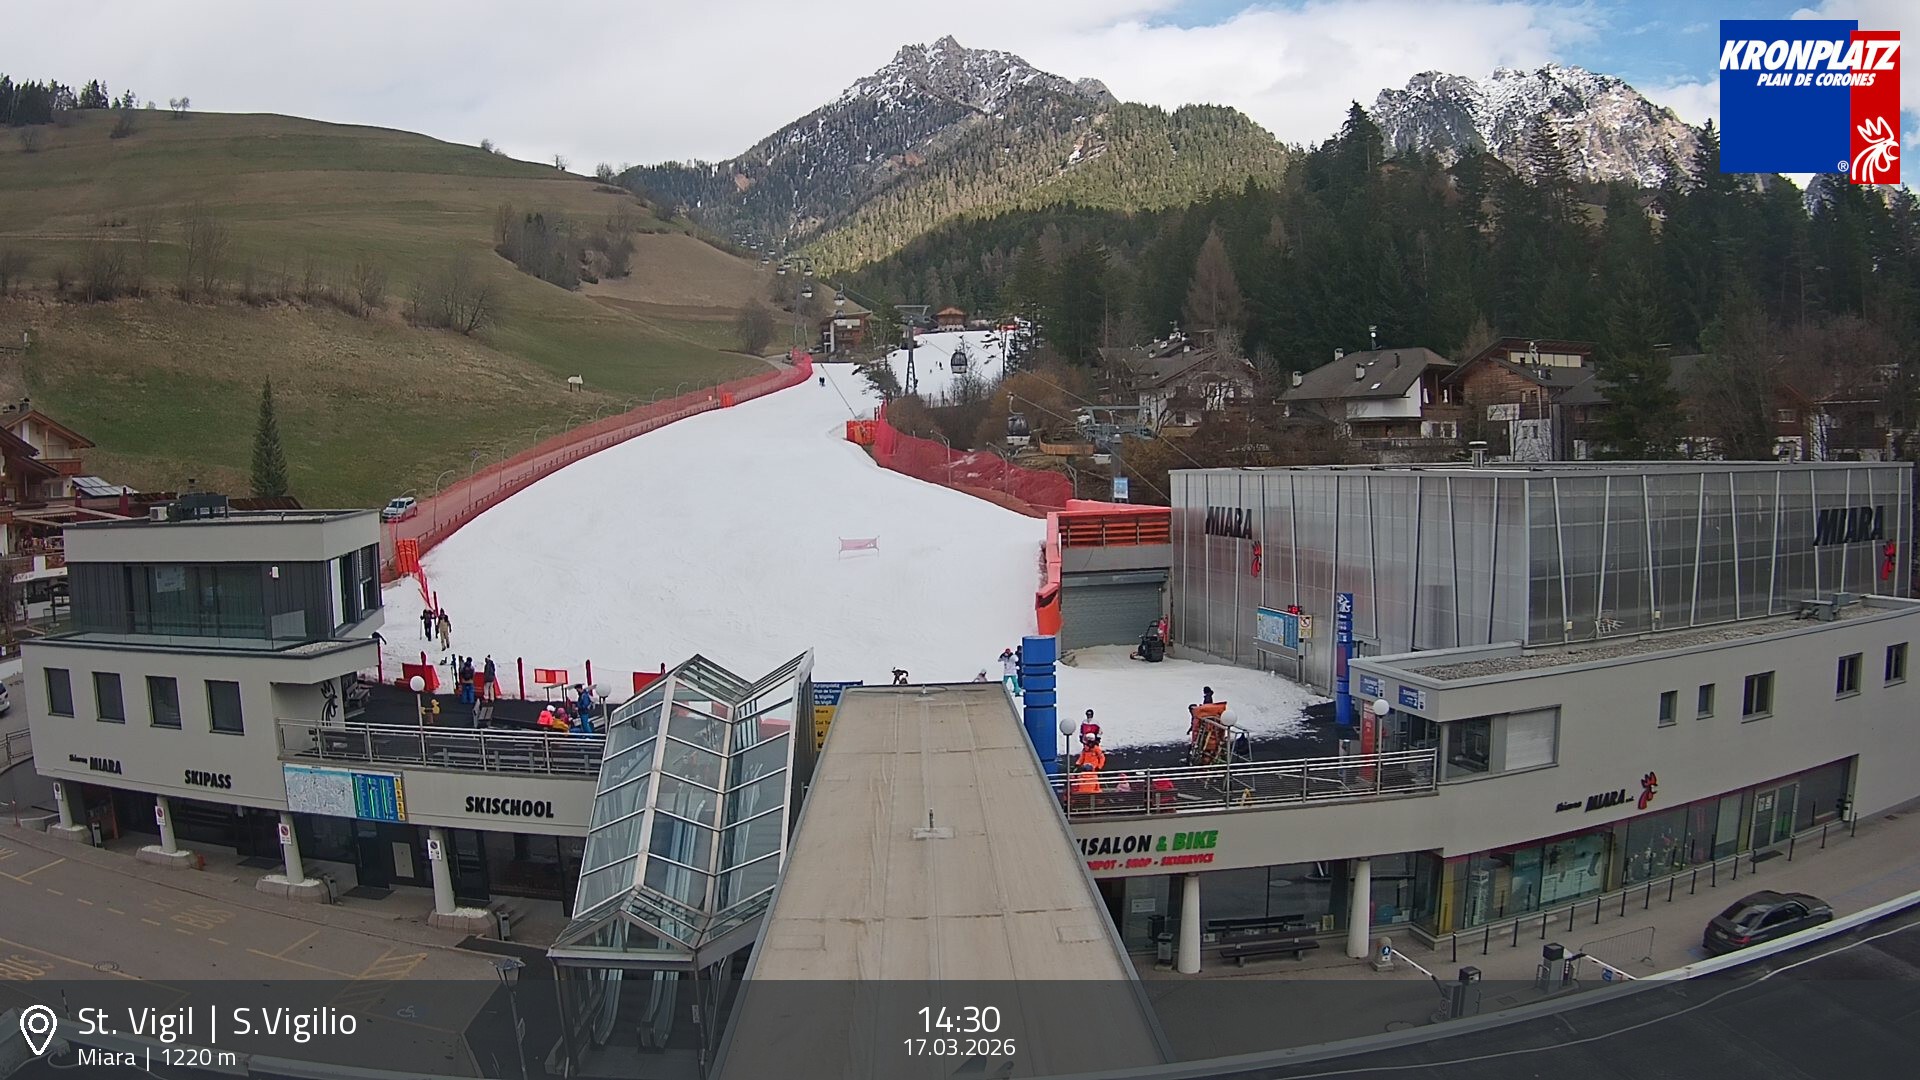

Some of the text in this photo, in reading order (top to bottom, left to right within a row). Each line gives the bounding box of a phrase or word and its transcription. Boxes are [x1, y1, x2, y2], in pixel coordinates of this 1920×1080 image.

[1205, 506, 1252, 539] MIARA
[1813, 506, 1883, 546] MIARA
[90, 756, 122, 775] MIARA
[185, 769, 232, 790] SKIPASS
[465, 796, 554, 819] SKISCHOOL
[1585, 789, 1626, 812] MIARA
[1155, 836, 1168, 852] &
[1172, 830, 1219, 850] BIKE
[169, 904, 237, 930] BUS
